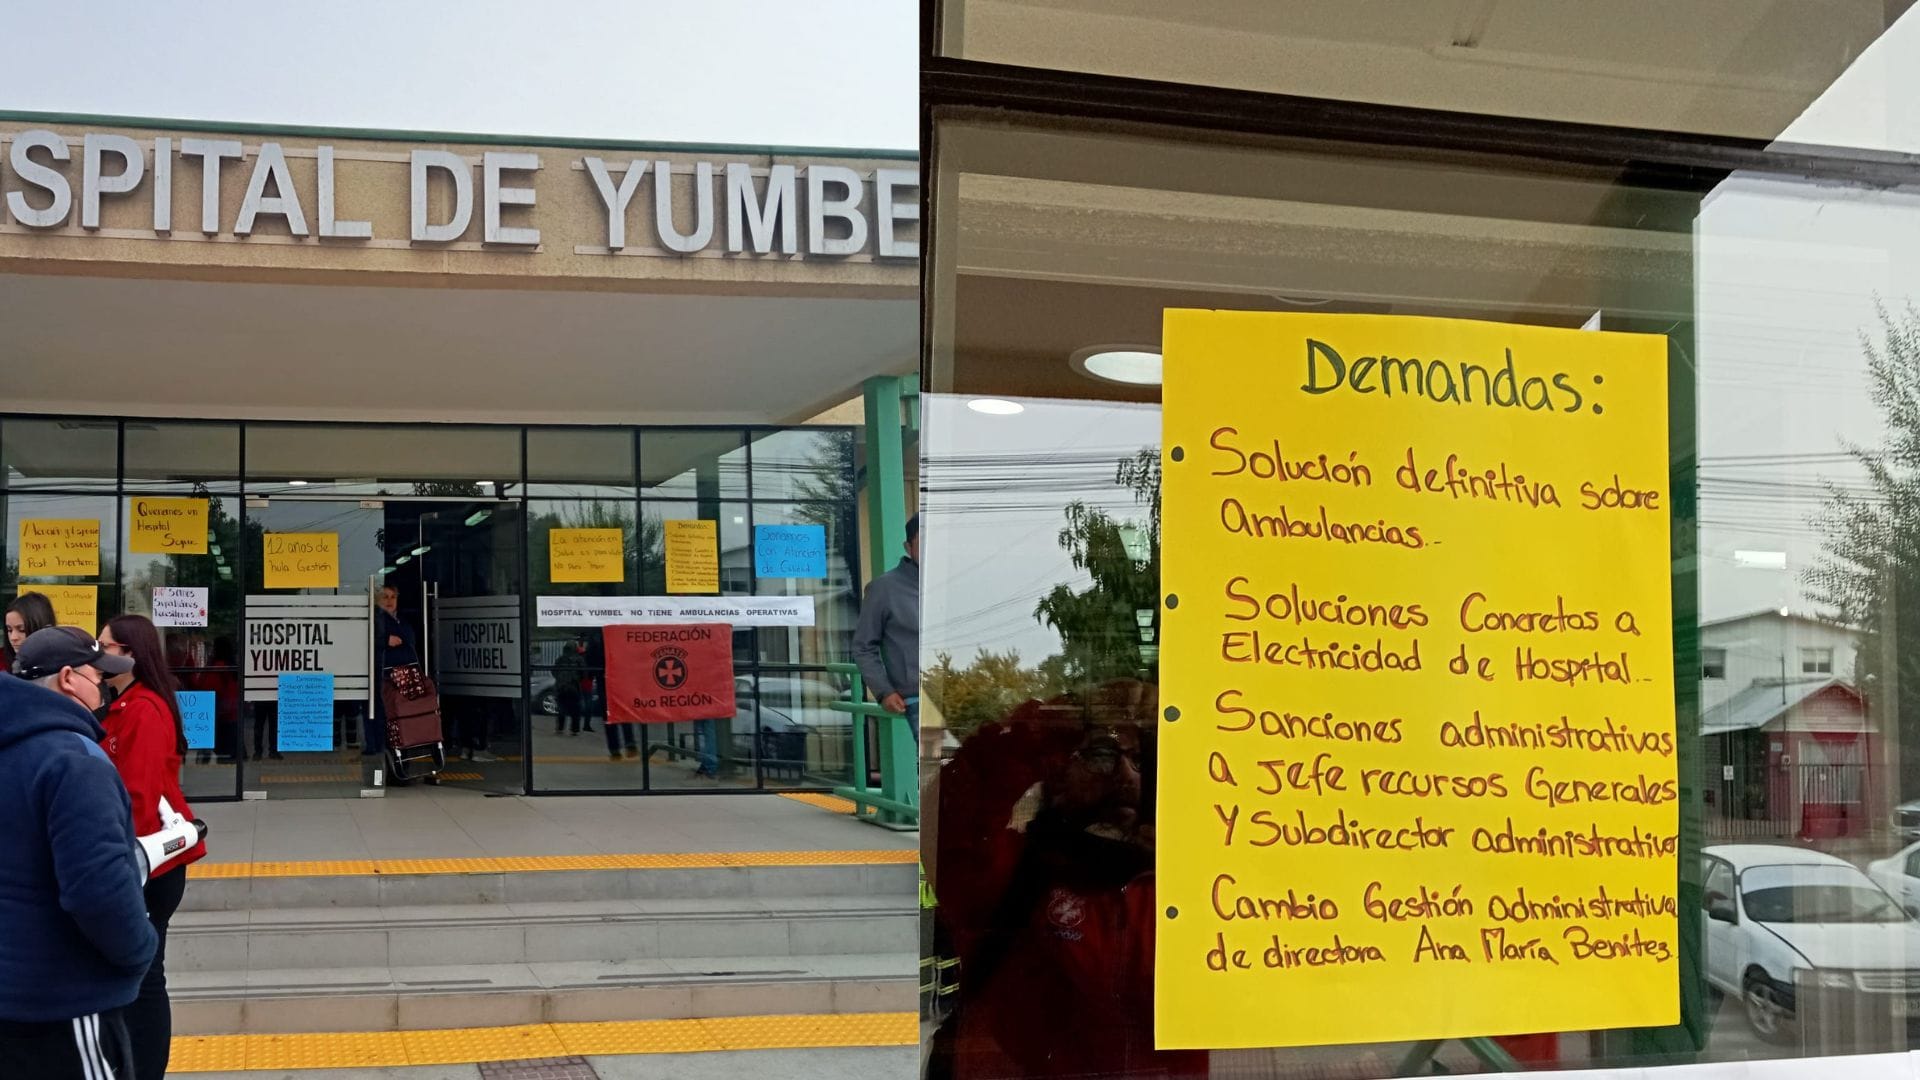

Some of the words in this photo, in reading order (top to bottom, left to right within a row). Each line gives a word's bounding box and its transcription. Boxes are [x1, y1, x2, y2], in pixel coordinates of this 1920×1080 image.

[410, 149, 541, 246] DE
[582, 156, 919, 259] YUMBE
[1300, 338, 1604, 415] Demandas:
[1210, 427, 1371, 488] Solución
[1396, 447, 1561, 508] definitiva
[267, 536, 285, 555] 12
[315, 537, 330, 553] de
[541, 609, 583, 617] HOSPITAL
[589, 609, 623, 617] YUMBEL
[630, 609, 643, 617] NO
[679, 609, 740, 617] AMBULANCIAS
[746, 609, 799, 617] OPERATIVAS
[1225, 576, 1429, 630] Soluciones
[250, 623, 333, 645] HOSPITAL
[454, 622, 514, 644] HOSPITAL
[626, 627, 711, 643] FEDERACIÓN
[1222, 630, 1421, 672] Electricidad
[1449, 643, 1495, 681] de
[250, 649, 324, 672] YUMBEL
[454, 647, 507, 669] YUMBEL
[659, 694, 712, 708] REGIÓN
[1215, 689, 1402, 743] Sanciones
[1441, 710, 1674, 758] administrativas
[1257, 753, 1347, 796] Jefe
[1361, 768, 1508, 797] recursos
[1525, 766, 1677, 808] Generales
[1249, 808, 1455, 850] Subdirector
[1212, 873, 1338, 921] Cambio
[1363, 881, 1473, 923] Gestión
[1489, 885, 1678, 923] administrativa
[1206, 932, 1252, 972] de
[1263, 934, 1386, 969] directora
[1413, 924, 1471, 963] Ana
[1481, 927, 1559, 965] María
